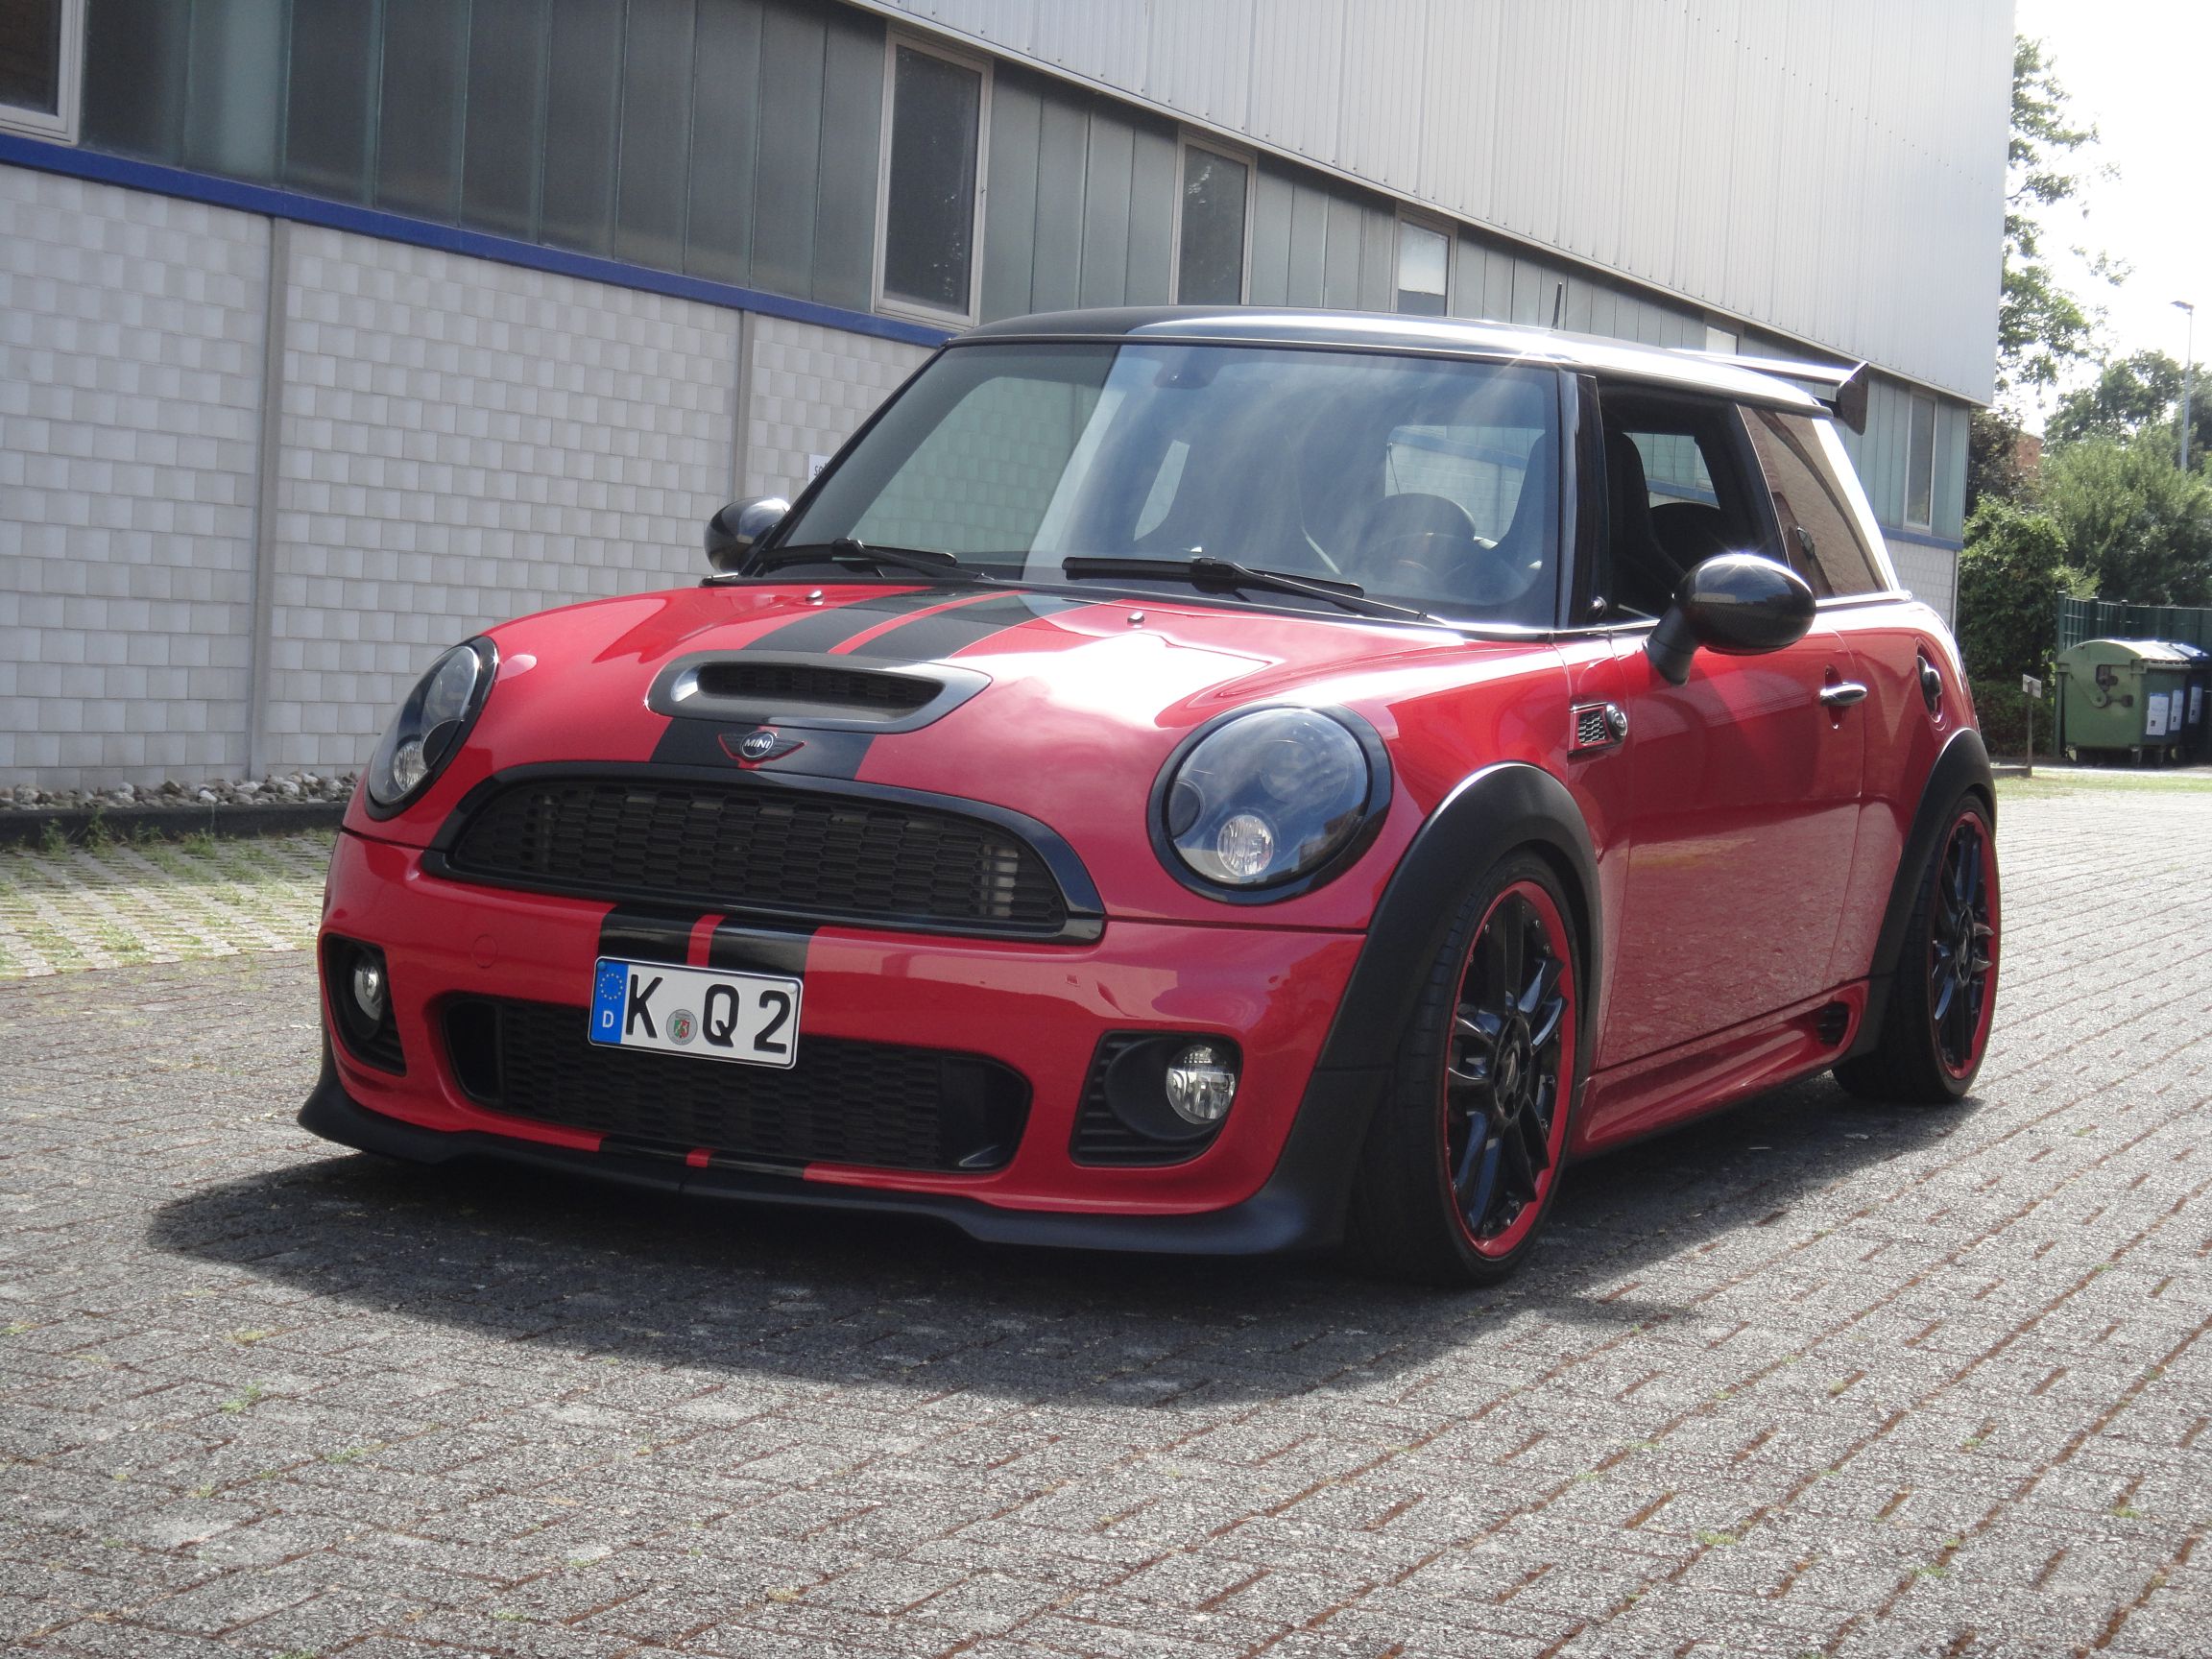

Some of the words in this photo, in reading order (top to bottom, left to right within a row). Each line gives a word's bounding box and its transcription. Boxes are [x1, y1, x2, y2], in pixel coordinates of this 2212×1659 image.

[744, 738, 771, 749] MINI
[625, 974, 663, 1039] K
[602, 1010, 614, 1028] D
